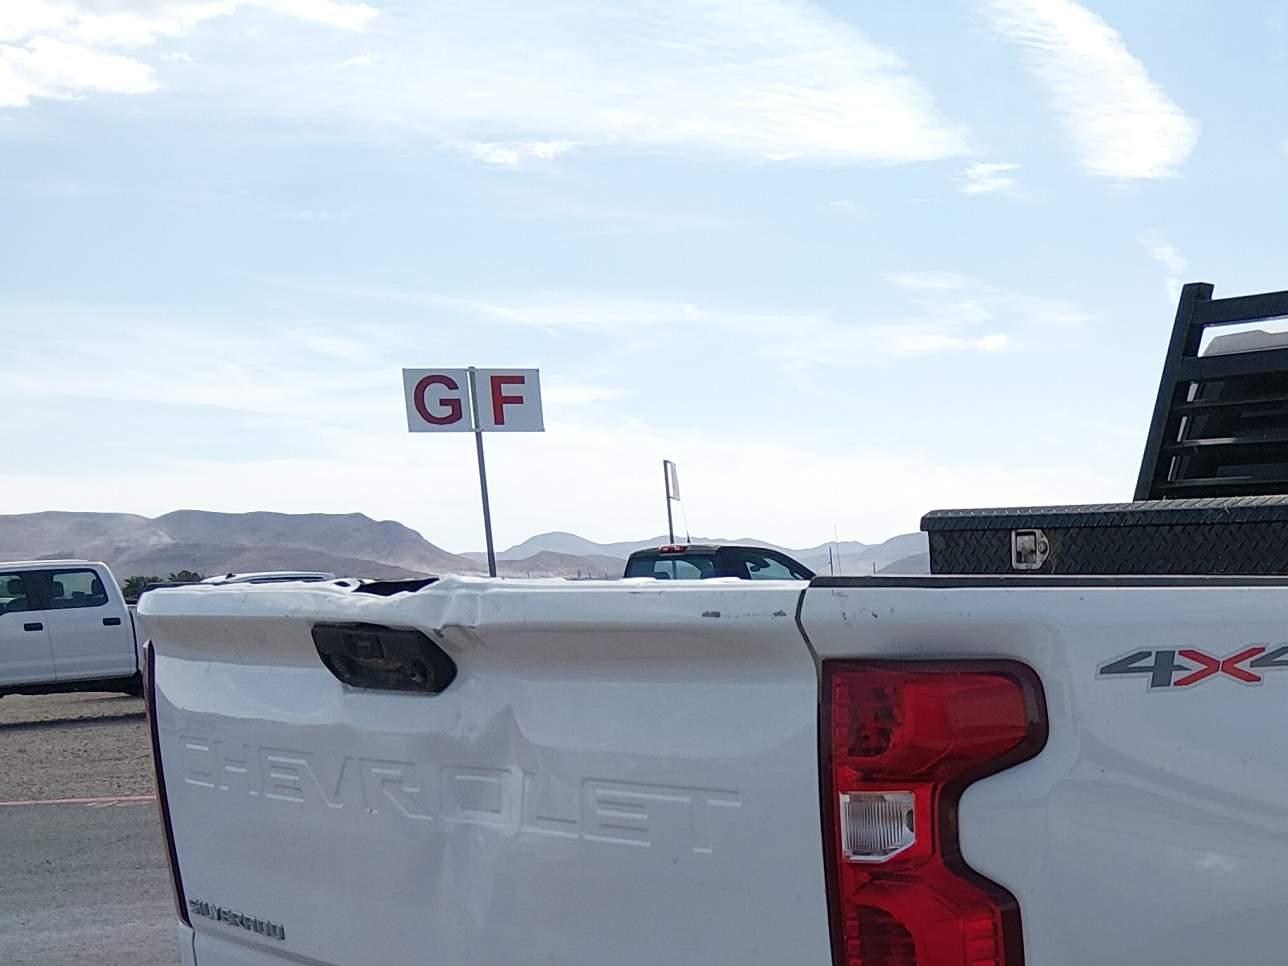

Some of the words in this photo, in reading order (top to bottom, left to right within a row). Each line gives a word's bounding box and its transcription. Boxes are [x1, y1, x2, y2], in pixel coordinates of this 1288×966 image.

[413, 374, 463, 426] G
[490, 375, 526, 426] F
[180, 734, 742, 854] CHEVROLET
